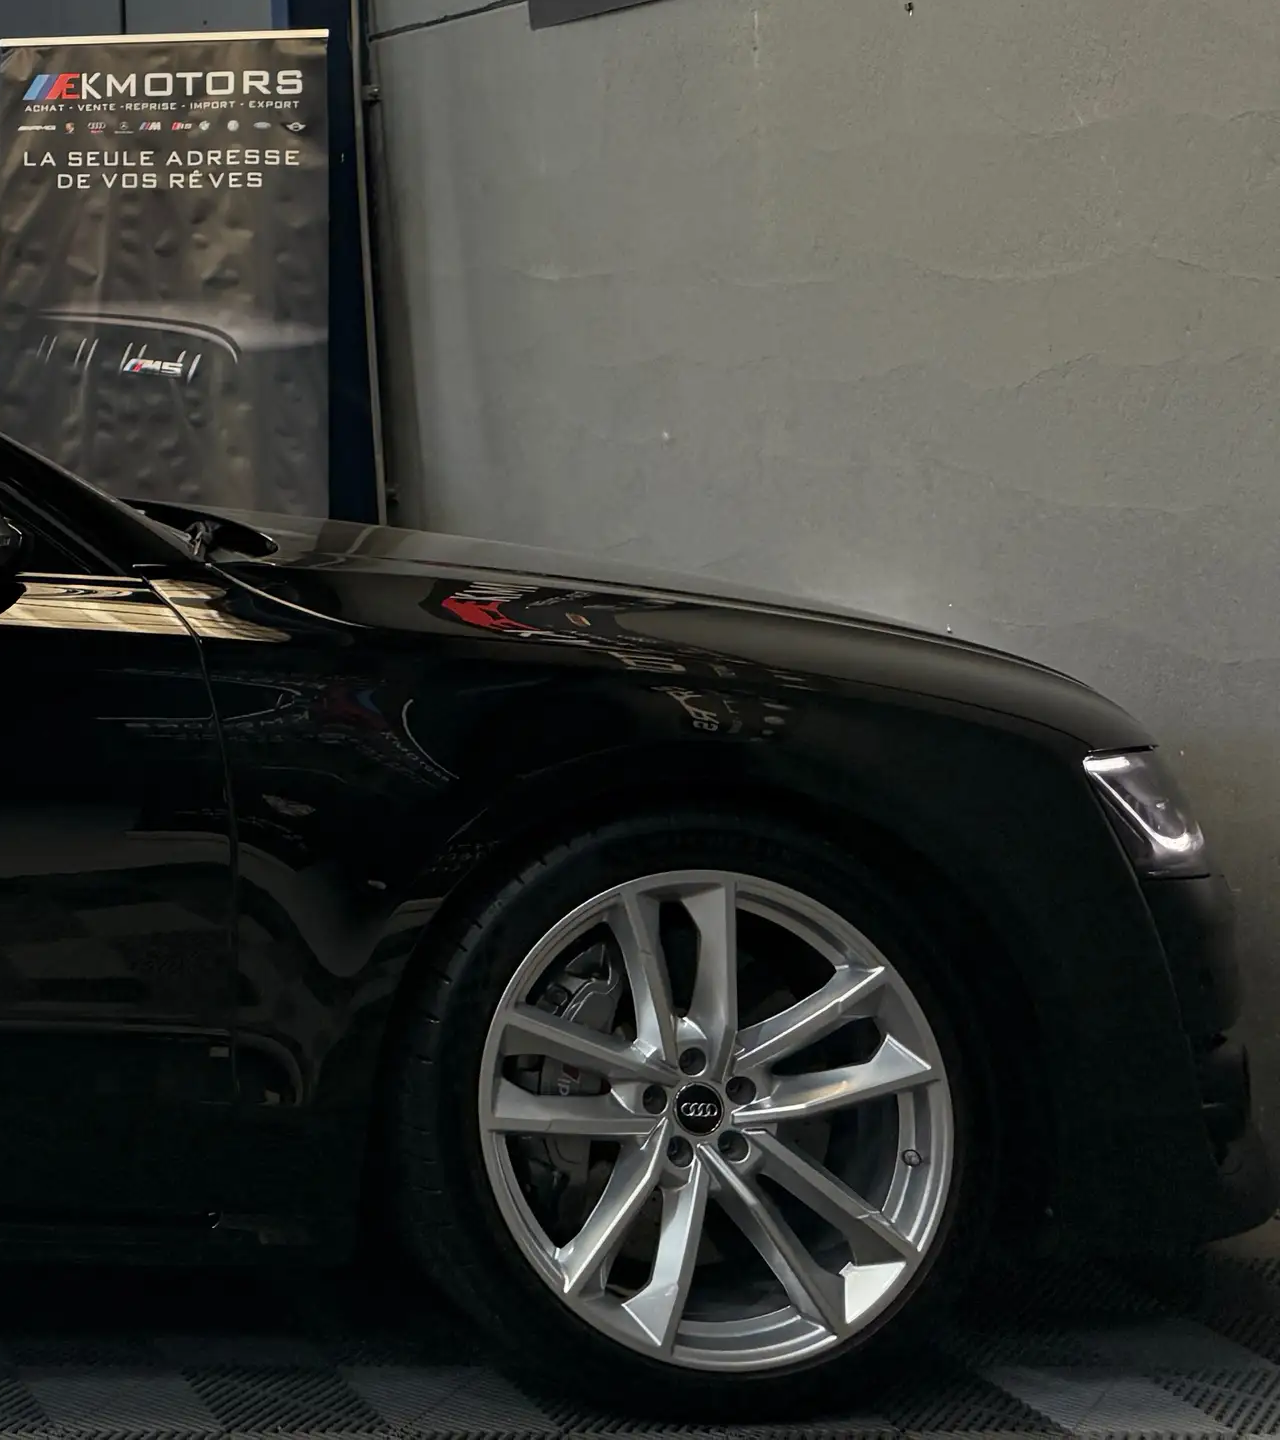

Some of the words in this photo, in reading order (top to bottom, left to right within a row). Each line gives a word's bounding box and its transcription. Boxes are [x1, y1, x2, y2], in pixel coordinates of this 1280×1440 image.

[25, 104, 65, 113] ACHAT
[78, 103, 117, 112] VENTE
[190, 100, 236, 109] IMPORT
[248, 100, 300, 109] EXPORT
[23, 151, 56, 167] LA
[68, 151, 154, 167] SEULE
[165, 149, 300, 166] ADRESSE
[57, 173, 91, 189] DE
[102, 173, 158, 189] VOS
[169, 170, 263, 189] RÊVES
